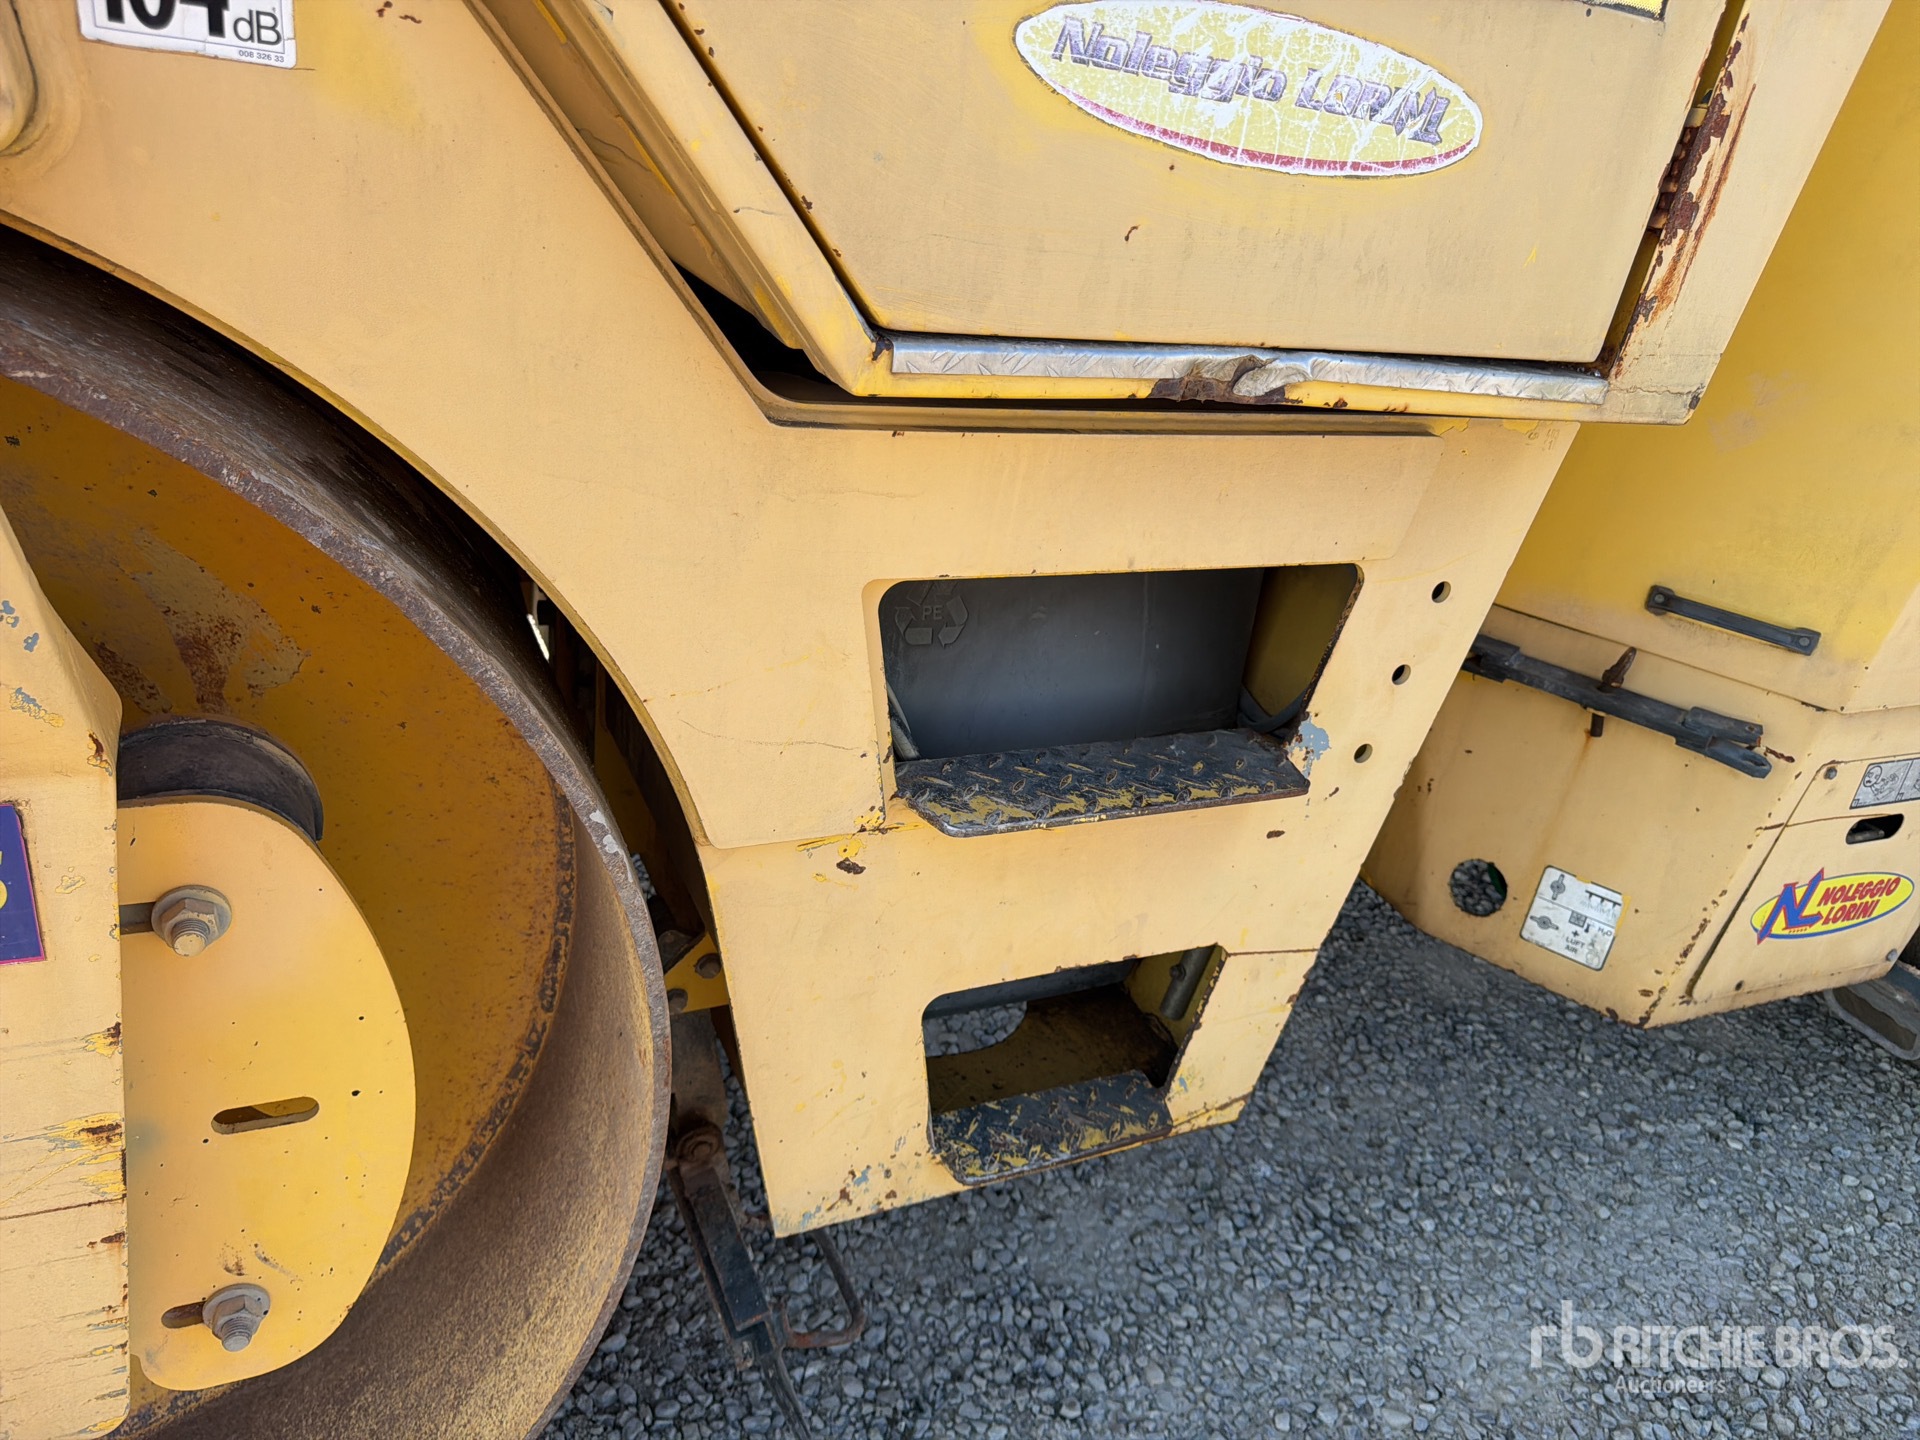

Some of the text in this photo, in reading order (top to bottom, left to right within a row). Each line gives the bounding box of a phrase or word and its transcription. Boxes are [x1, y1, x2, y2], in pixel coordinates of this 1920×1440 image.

[233, 9, 282, 45] dB
[238, 50, 285, 63] 008 326 33
[1051, 15, 1287, 103] Noleggio
[922, 605, 943, 620] PE
[1817, 877, 1901, 907] NOLEGGIO
[1822, 899, 1880, 926] LORINI
[1564, 944, 1578, 955] AIR
[1565, 936, 1585, 949] LUFT
